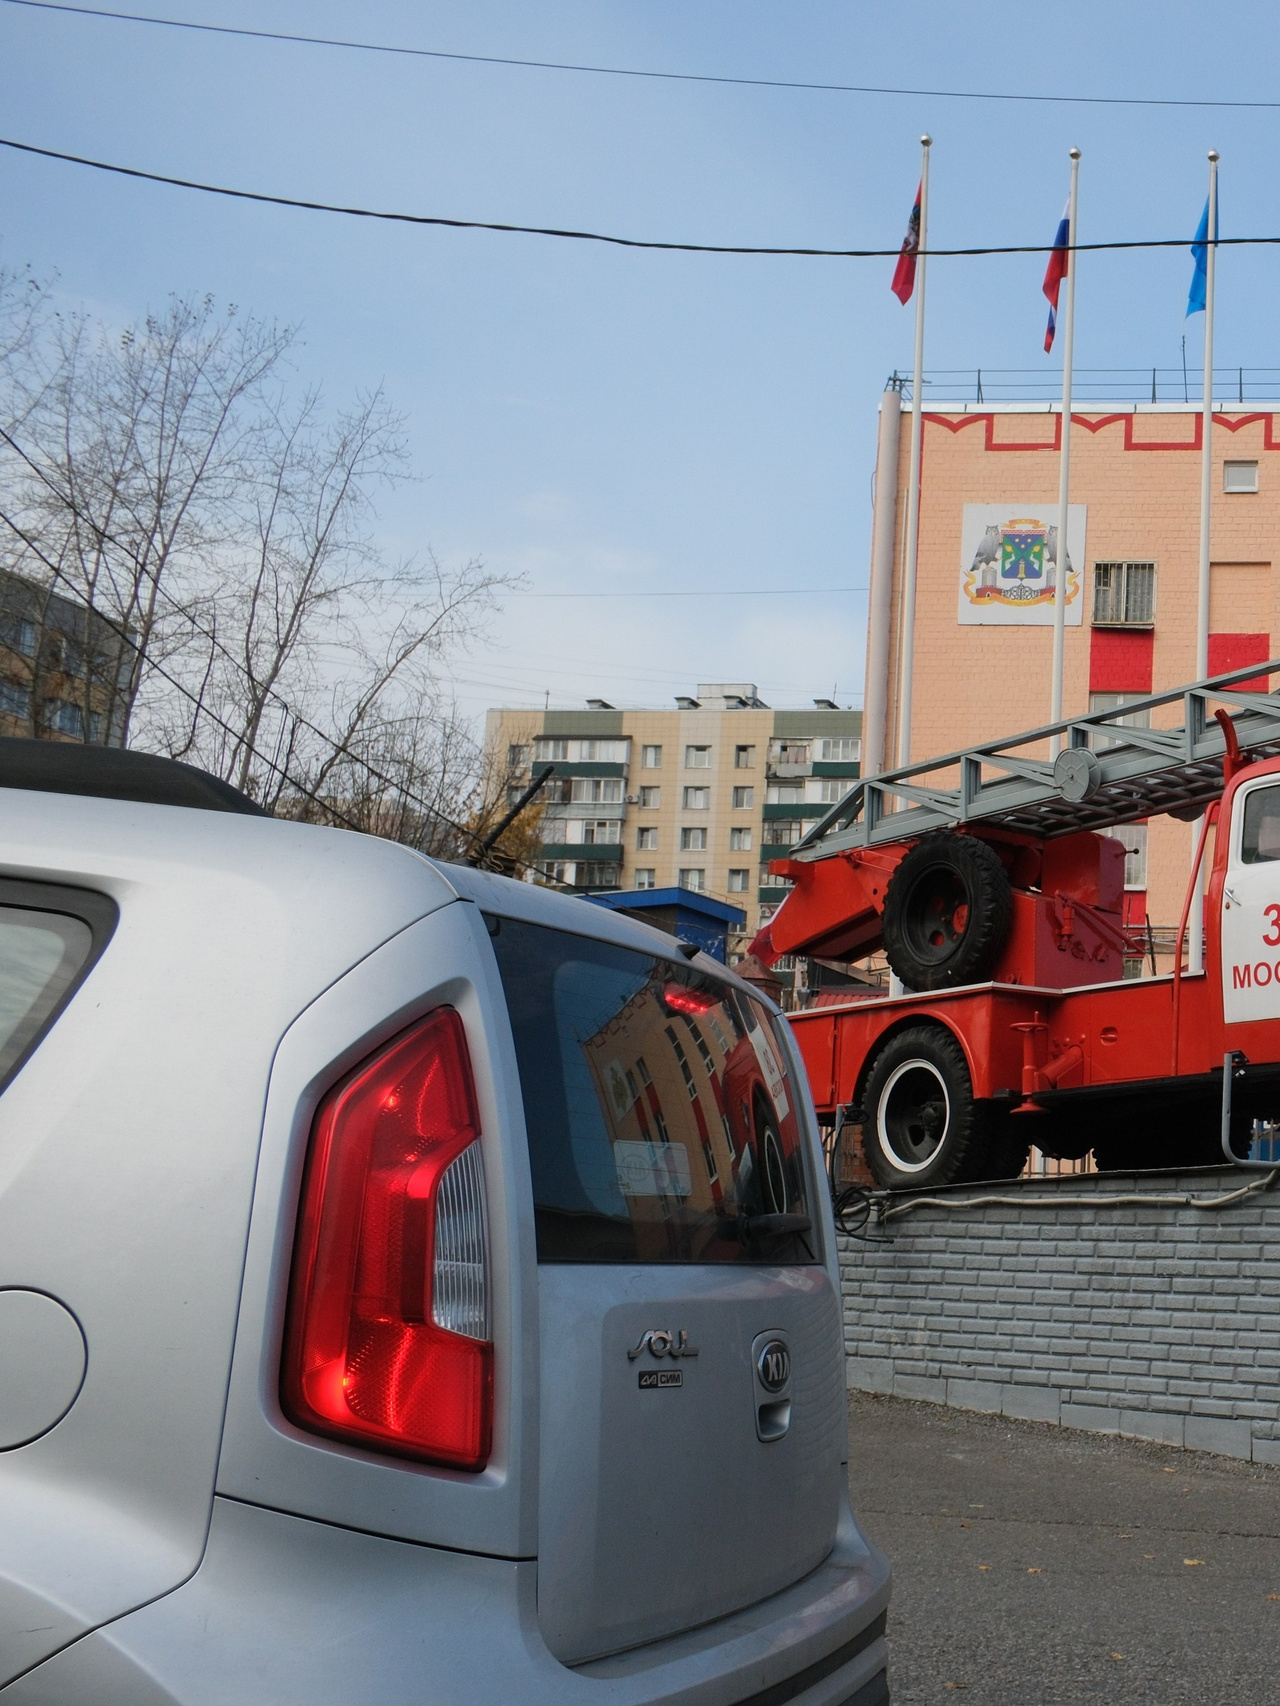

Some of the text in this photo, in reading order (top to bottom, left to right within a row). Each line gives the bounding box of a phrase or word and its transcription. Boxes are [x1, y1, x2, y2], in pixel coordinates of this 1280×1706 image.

[628, 1329, 699, 1361] SOUL
[660, 1373, 681, 1385] СИМ
[766, 1352, 790, 1382] KIA
